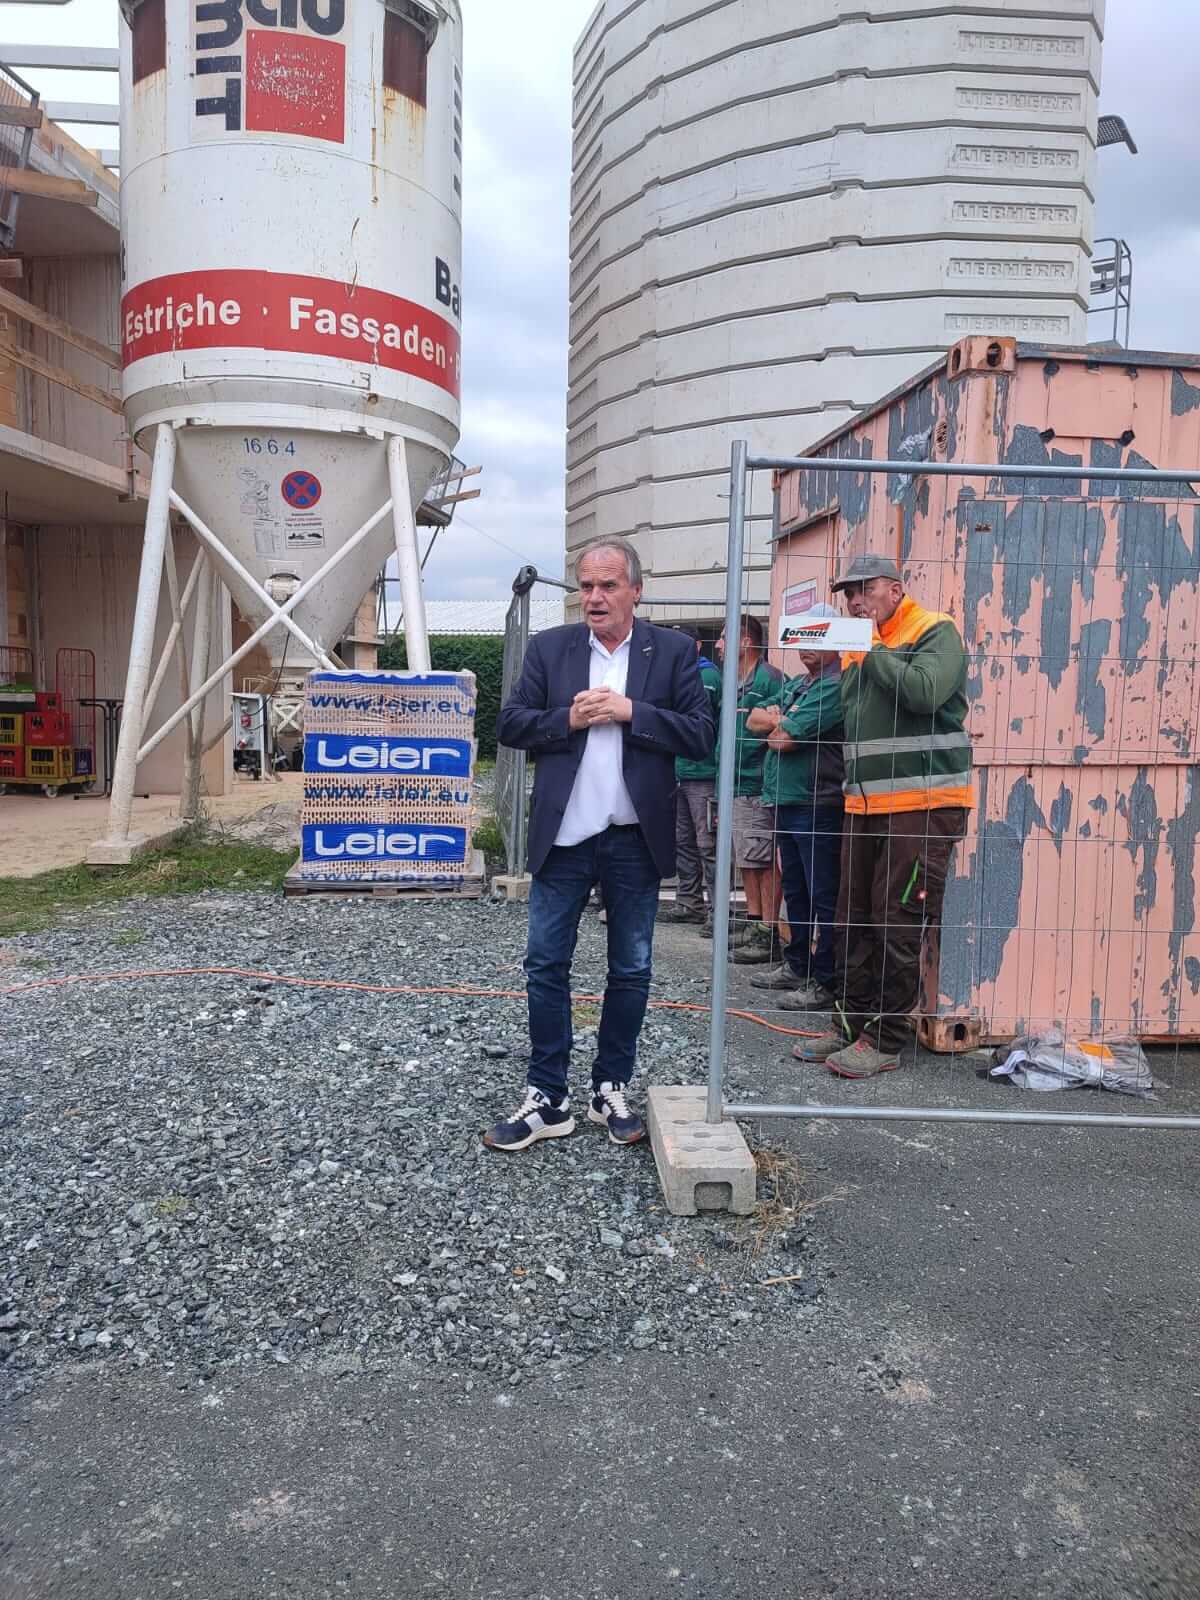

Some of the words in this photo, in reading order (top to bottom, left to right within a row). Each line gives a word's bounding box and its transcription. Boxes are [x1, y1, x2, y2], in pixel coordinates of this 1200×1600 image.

[959, 34, 1077, 54] LIEBHERR
[958, 91, 1073, 111] LIEBHERR
[958, 148, 1072, 167] LIEBHERR
[956, 204, 1070, 222] LIEBHERR
[952, 261, 1067, 278] LIEBHERR
[125, 293, 241, 345] Estriche
[289, 296, 447, 369] Fassaden
[948, 317, 1063, 332] LIEBHERR
[317, 740, 461, 770] Leier
[304, 784, 469, 804] www.leier.eu
[315, 829, 456, 856] Leier
